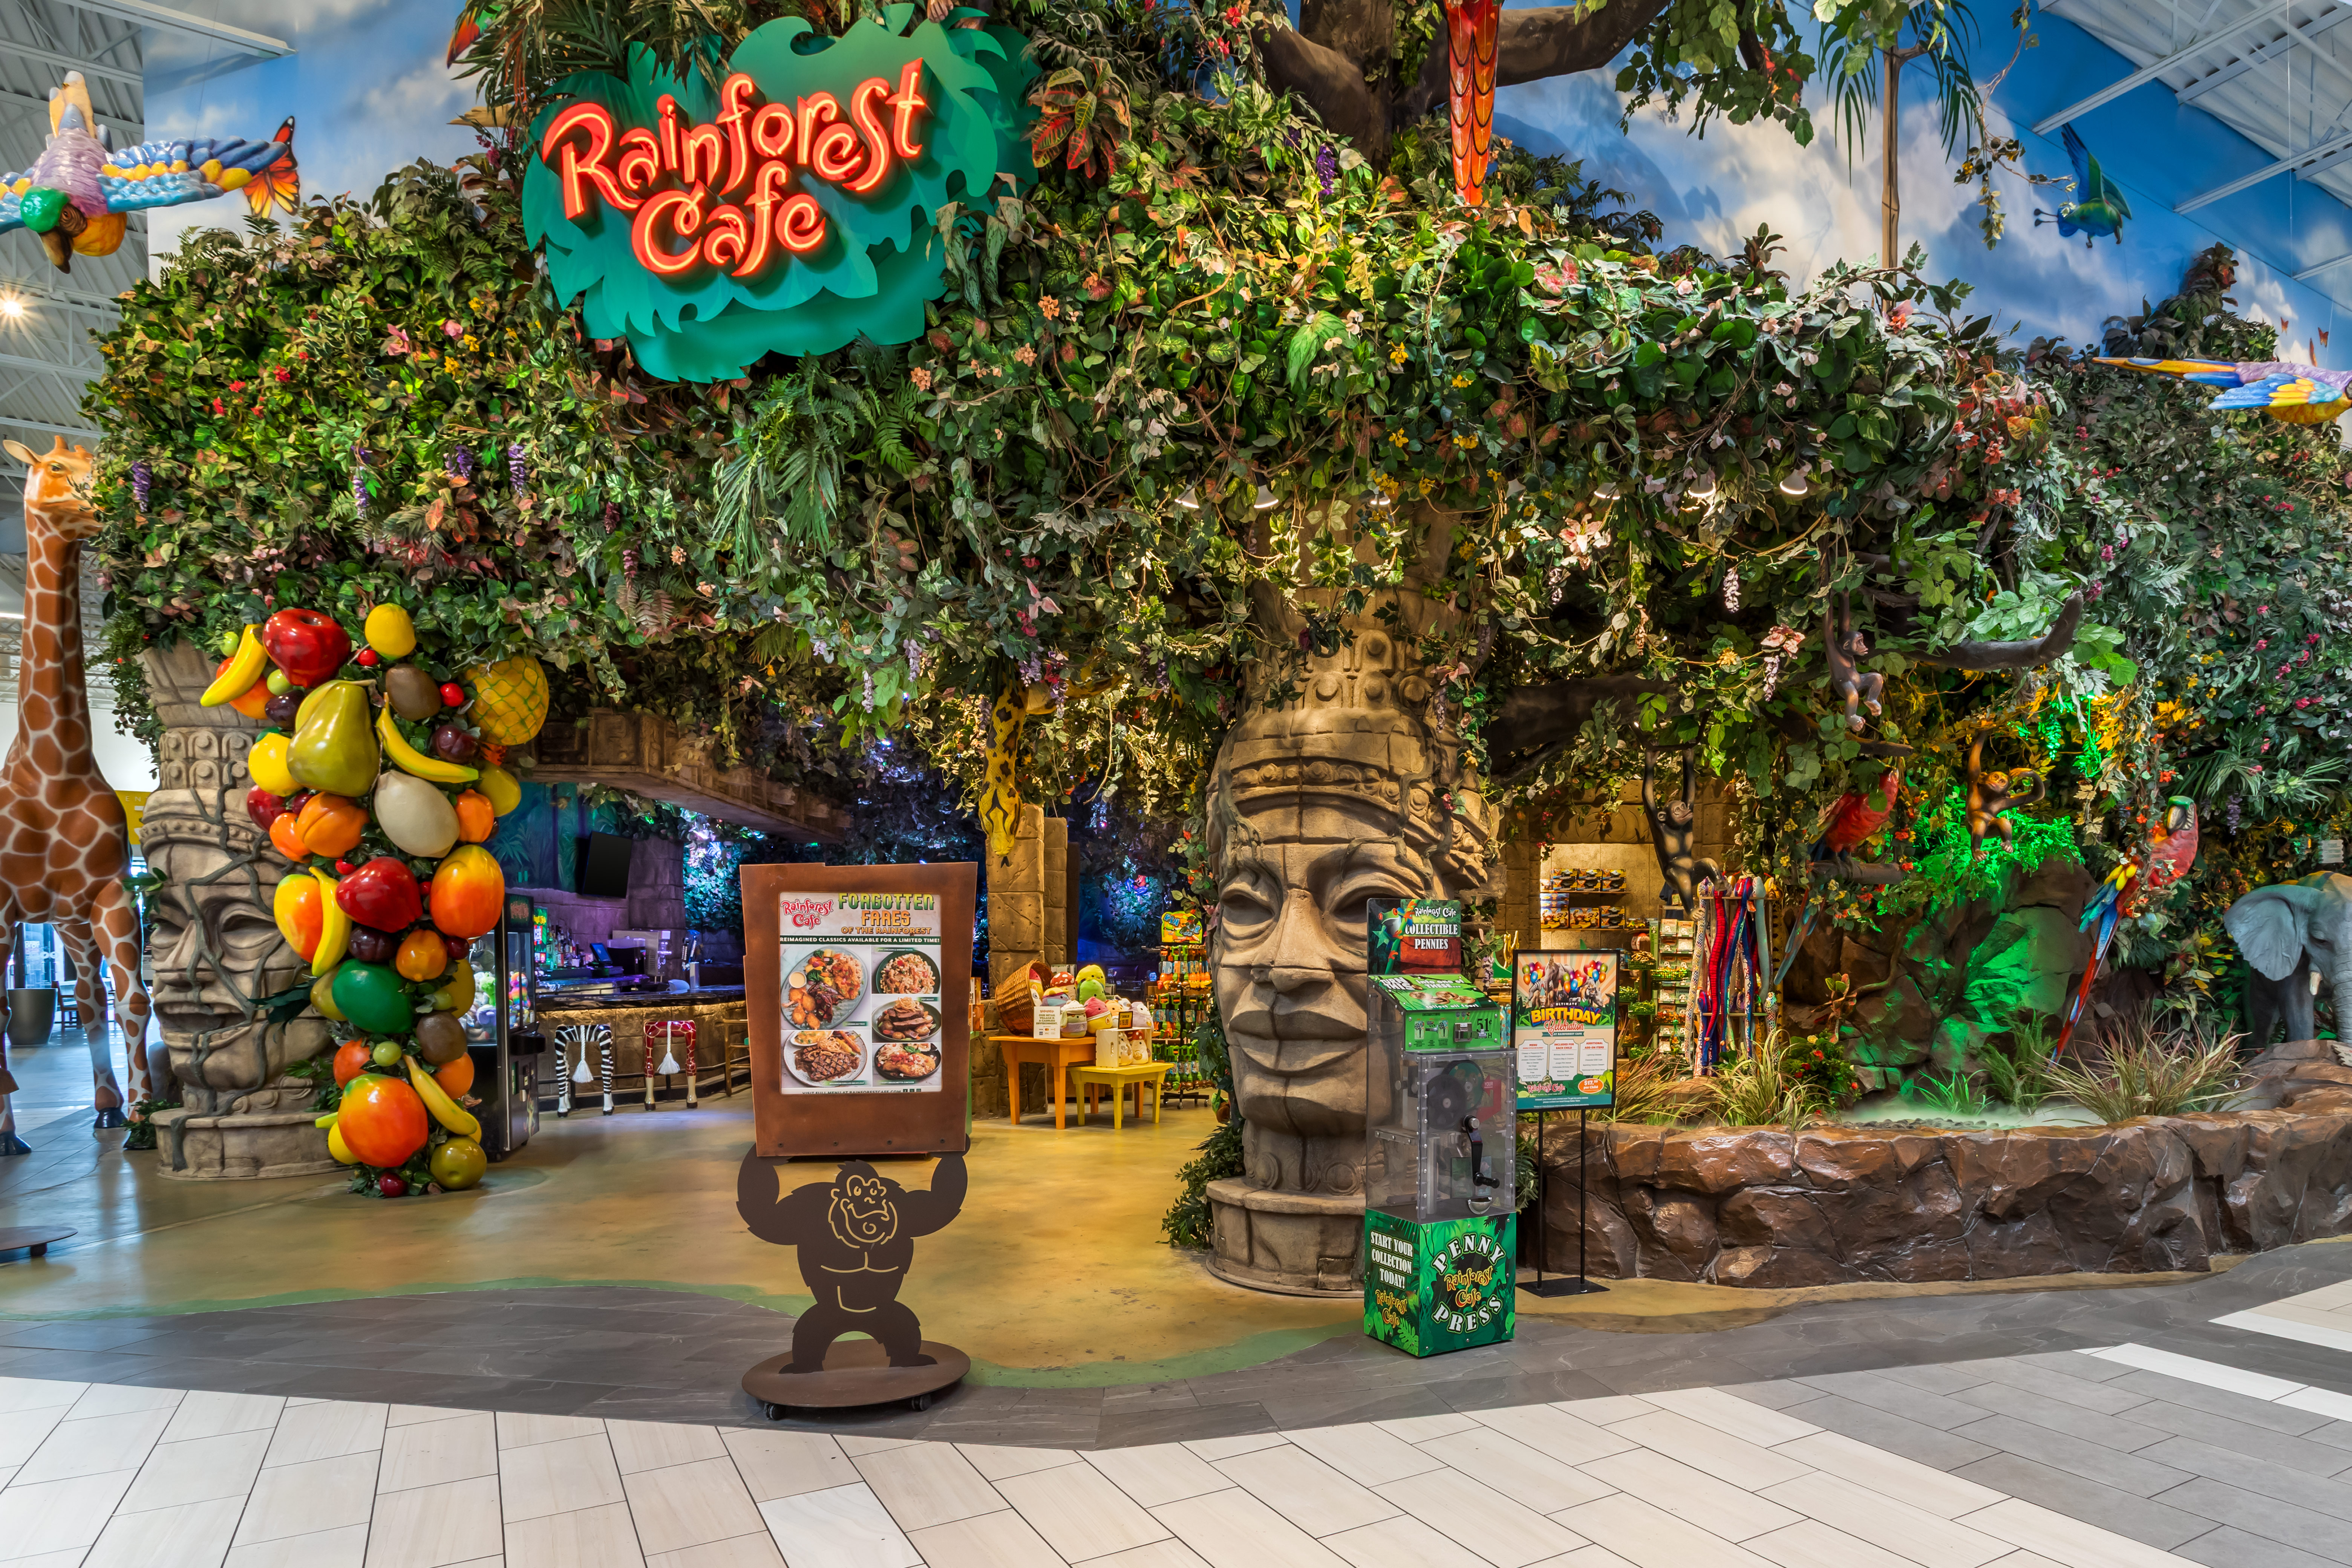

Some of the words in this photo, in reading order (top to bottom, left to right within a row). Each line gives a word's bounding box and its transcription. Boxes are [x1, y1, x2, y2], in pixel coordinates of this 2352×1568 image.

[542, 57, 925, 220] Rainforest
[631, 160, 825, 277] Cafe
[781, 899, 834, 916] Rainforest
[838, 893, 934, 910] FORGOTTEN
[792, 913, 821, 929] Cafe
[861, 911, 911, 926] FARES
[1414, 906, 1441, 917] Rainforest
[1442, 908, 1456, 918] Cafe
[1405, 924, 1458, 934] COLLECTIBLE
[1415, 939, 1448, 949] PENNIES
[1531, 1007, 1601, 1026] BIRTHDAY
[1544, 1018, 1583, 1036] Celebration
[1527, 1084, 1551, 1093] Rainforest
[1552, 1083, 1565, 1093] Cafe
[1371, 1231, 1392, 1250] START
[1393, 1238, 1413, 1257] YOUR
[1372, 1248, 1412, 1274] COLLECTION
[1432, 1234, 1505, 1274] PENNY
[1380, 1268, 1405, 1289] TODAY!
[1444, 1265, 1493, 1291] Rainforest
[1375, 1289, 1407, 1315] Rainforest
[1455, 1288, 1481, 1307] Cafe
[1382, 1308, 1400, 1328] Cafe
[1433, 1296, 1501, 1332] PRESS
